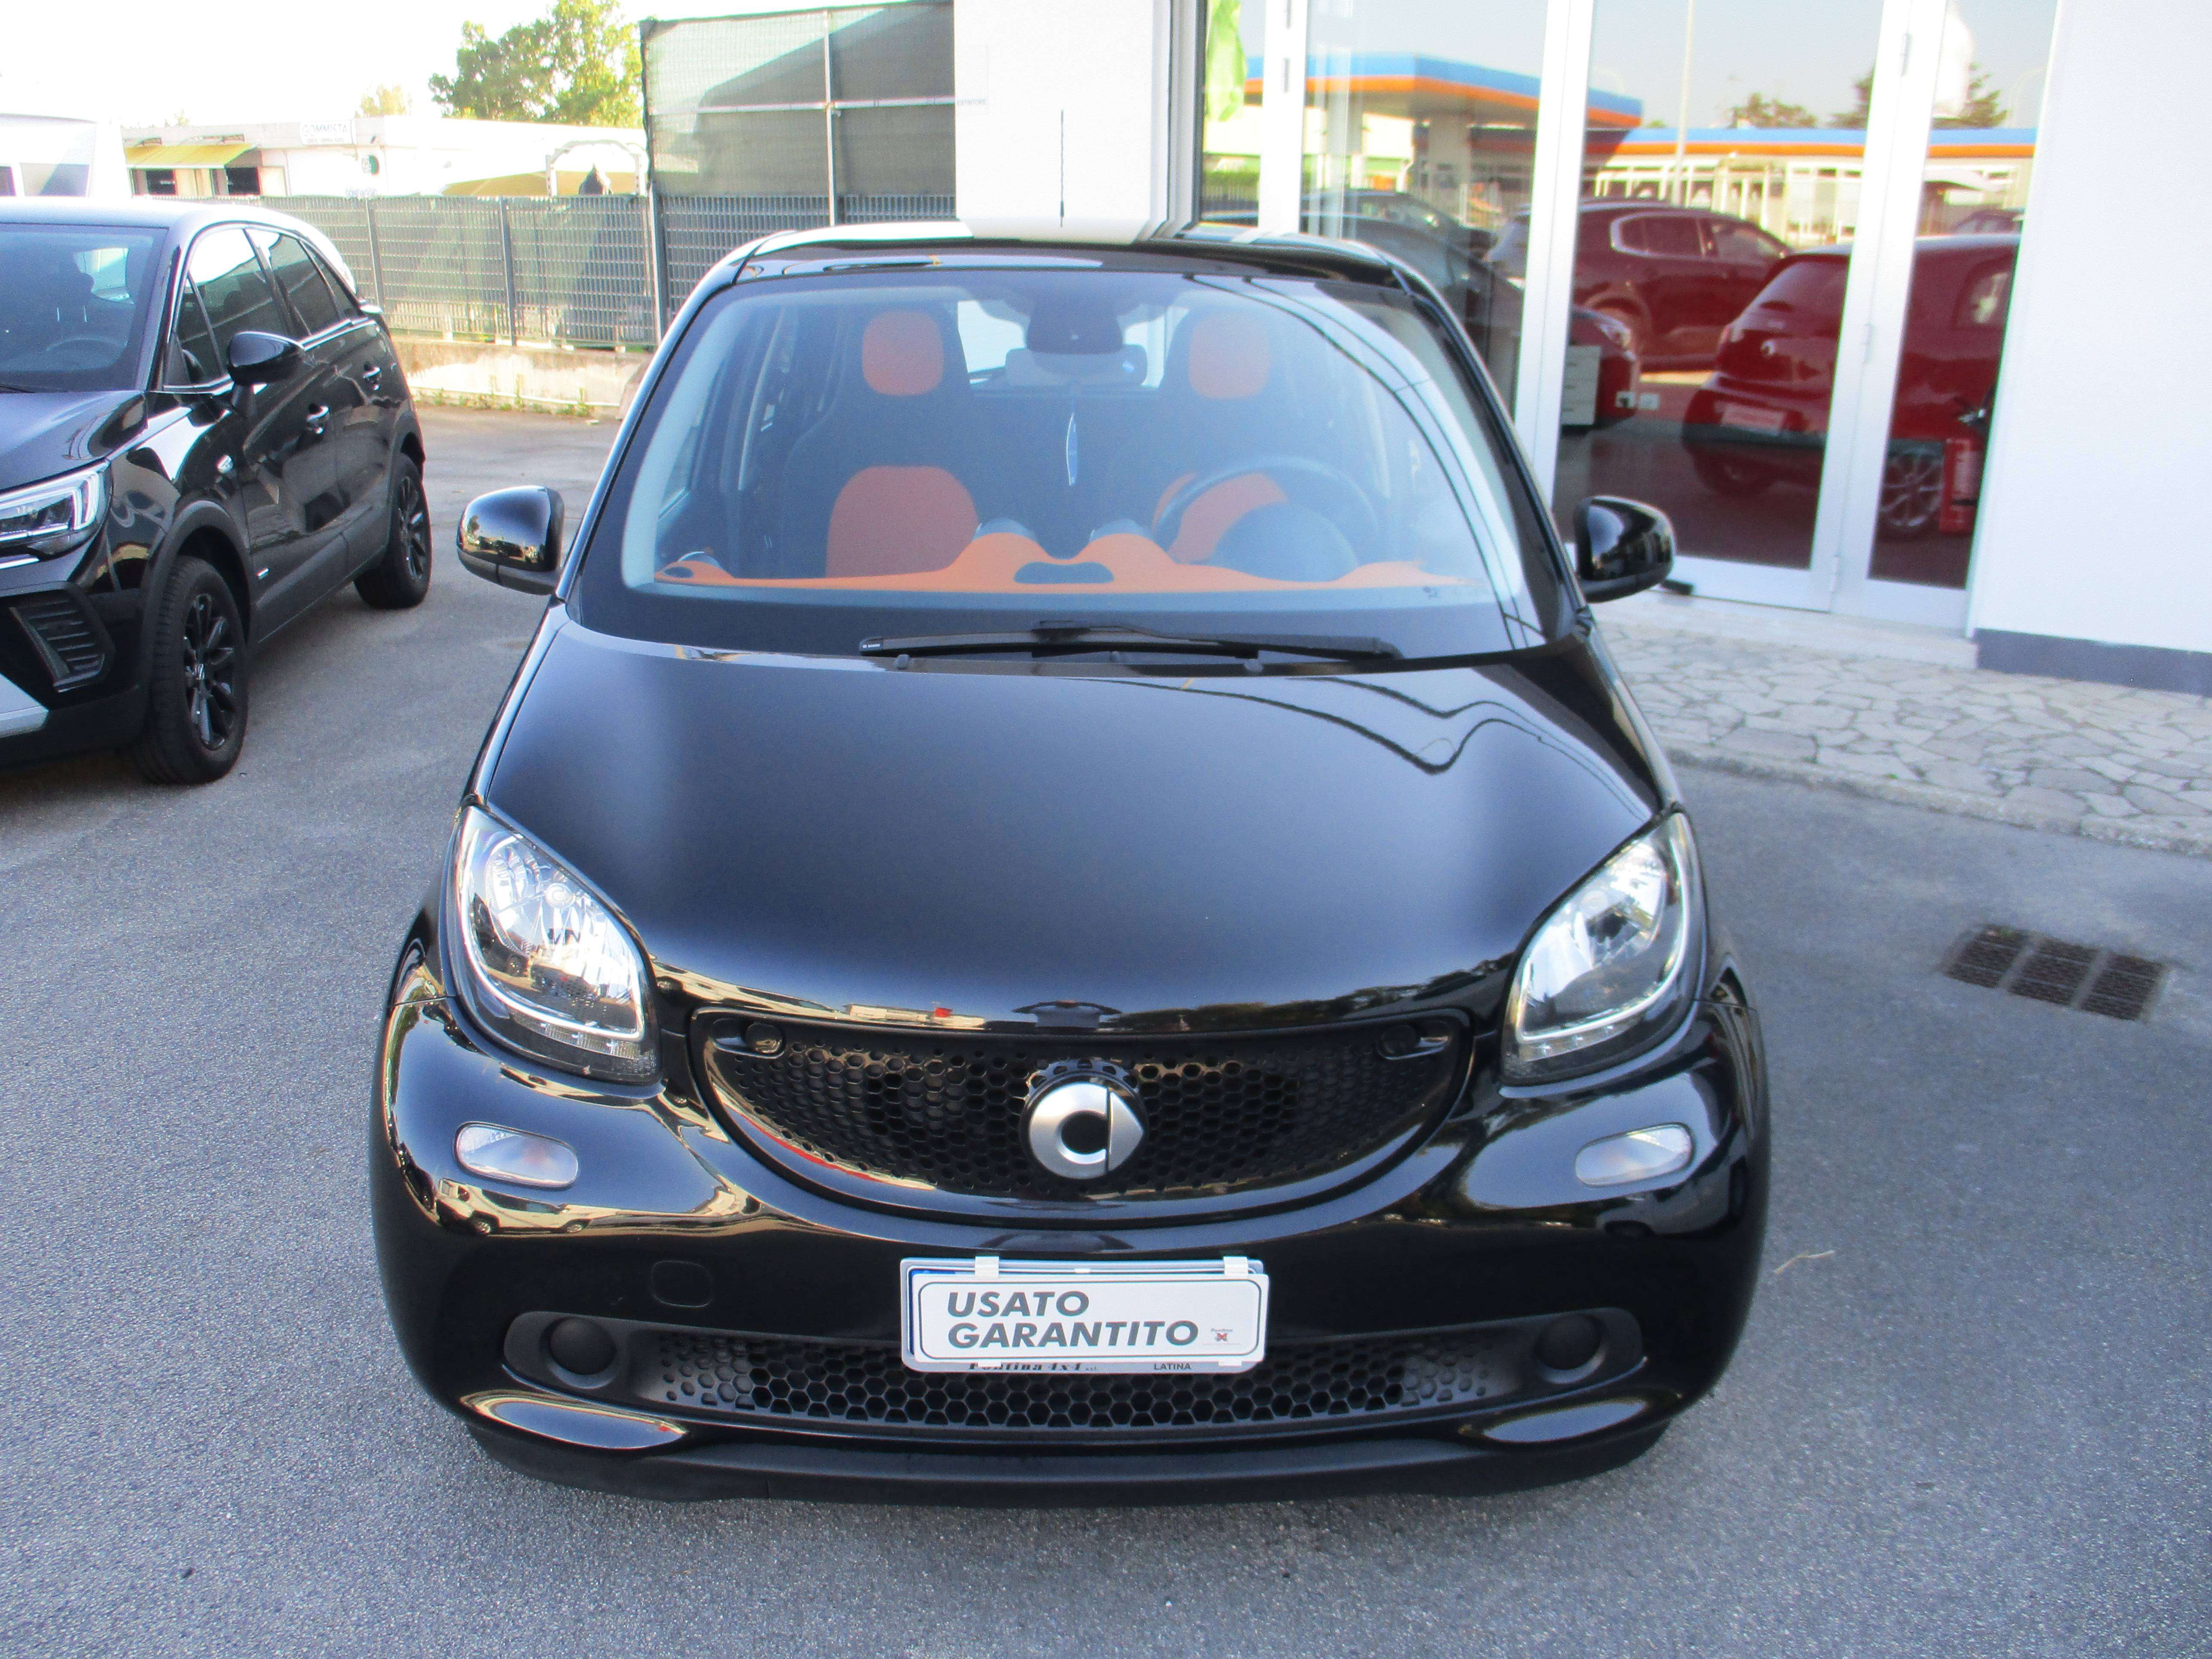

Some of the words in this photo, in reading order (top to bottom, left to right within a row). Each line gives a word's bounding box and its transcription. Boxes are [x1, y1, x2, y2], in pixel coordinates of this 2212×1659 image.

[302, 124, 347, 136] GOMMISTA
[948, 1291, 1089, 1317] USATO
[948, 1320, 1198, 1349] GARANTITO
